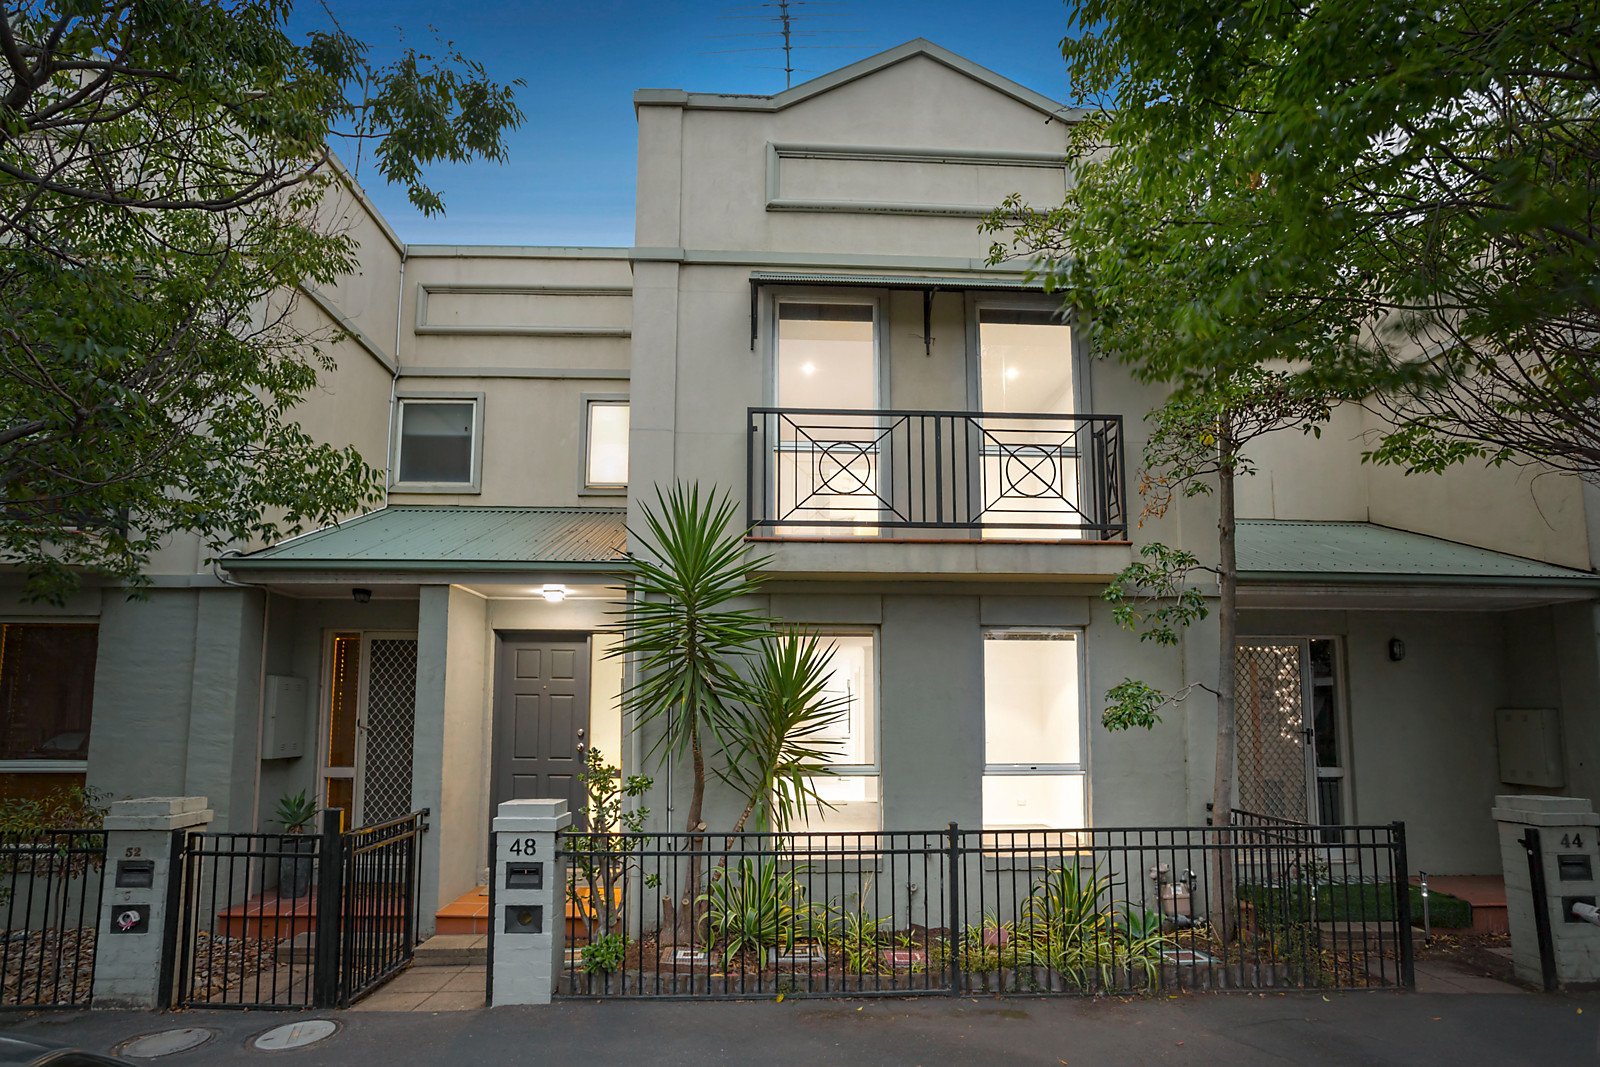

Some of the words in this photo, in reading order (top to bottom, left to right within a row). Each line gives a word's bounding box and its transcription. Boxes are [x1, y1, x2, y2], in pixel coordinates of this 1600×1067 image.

[509, 838, 536, 856] 48
[1560, 833, 1583, 848] 44
[125, 847, 142, 857] 52
